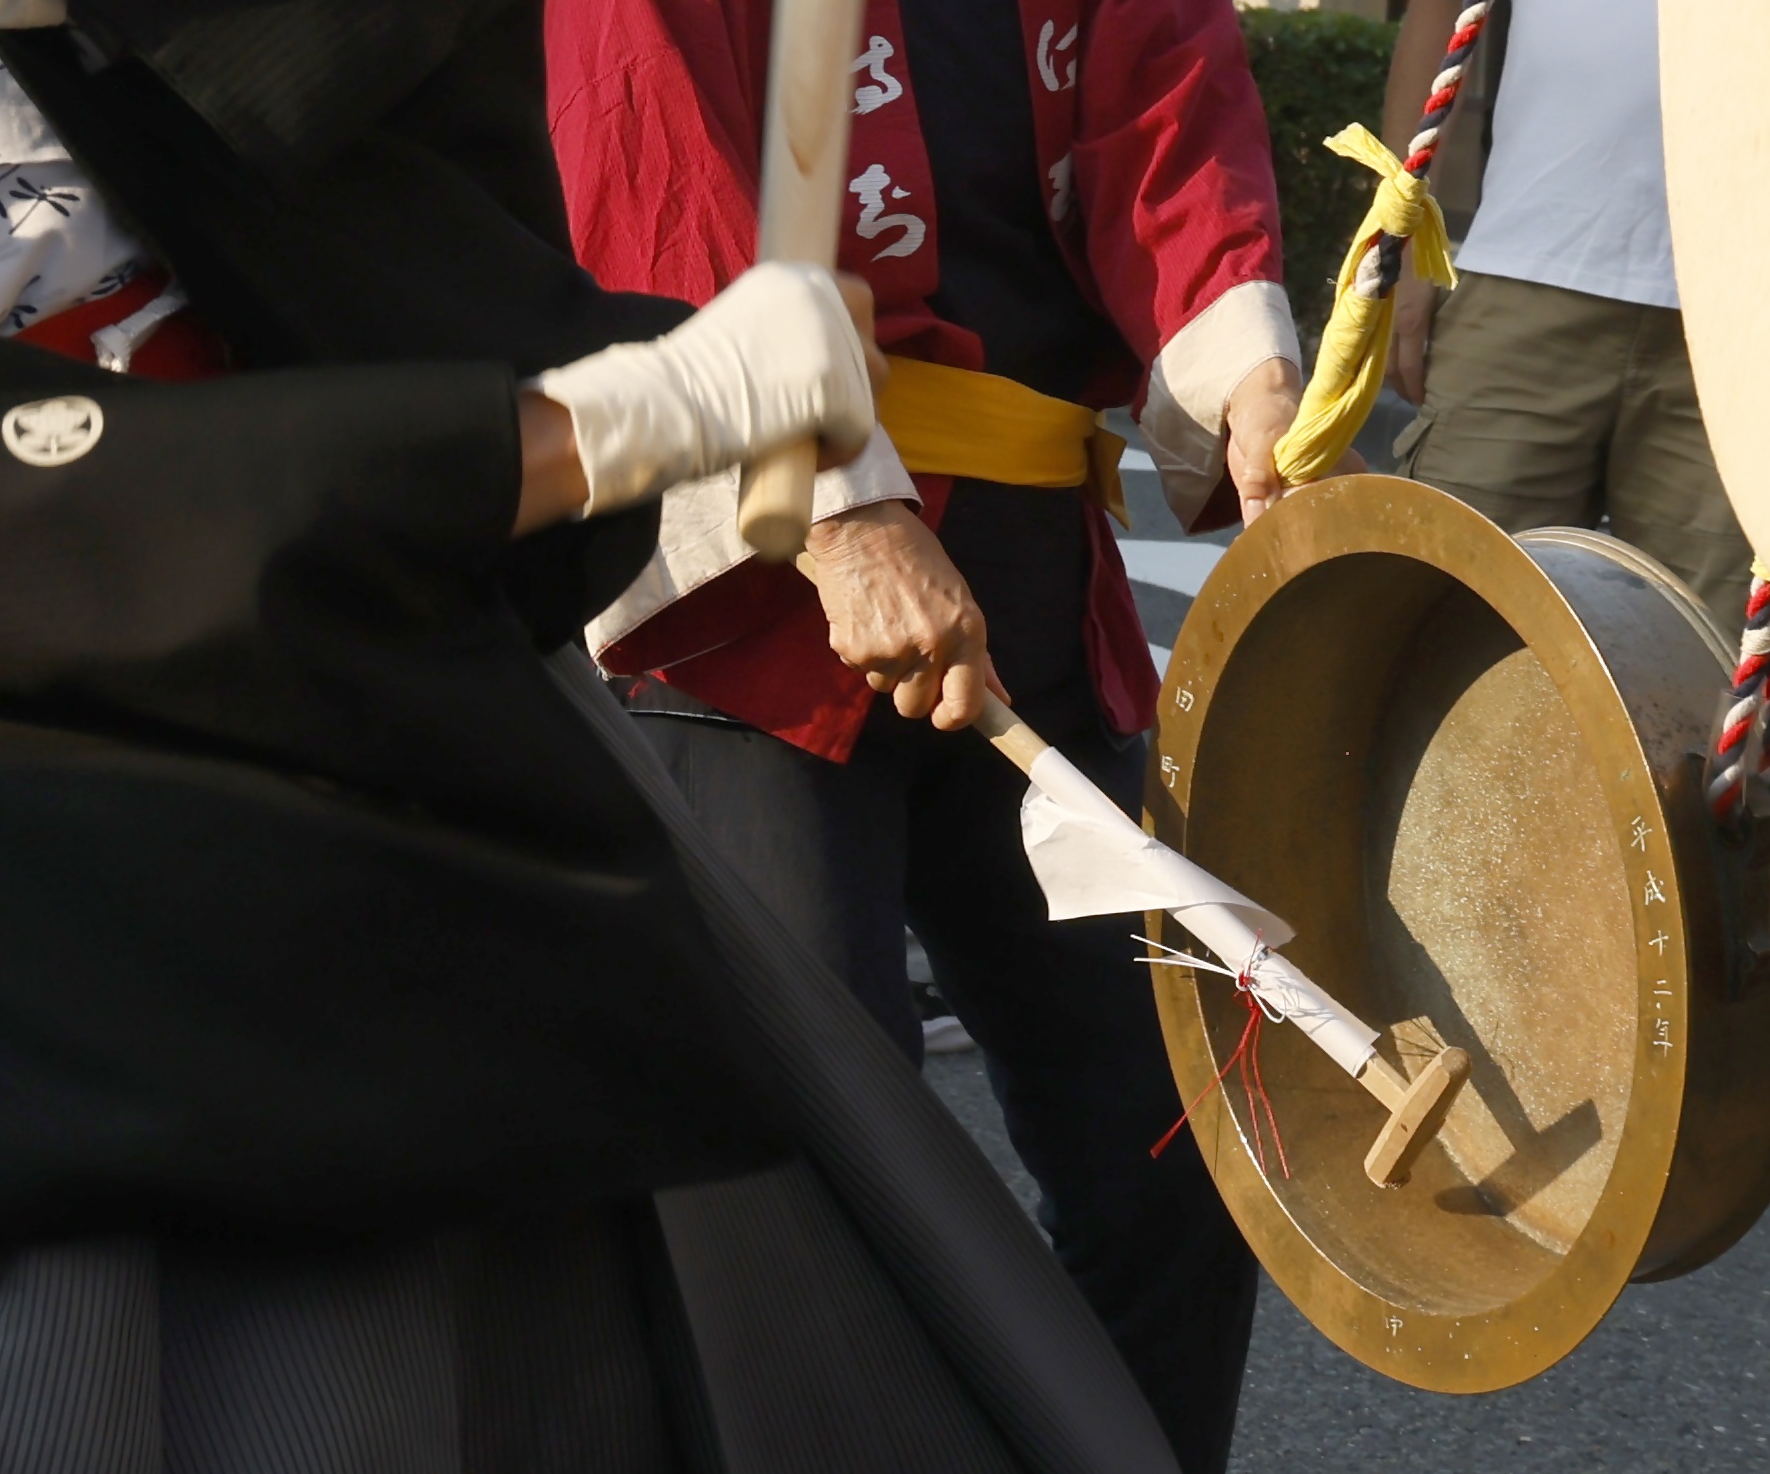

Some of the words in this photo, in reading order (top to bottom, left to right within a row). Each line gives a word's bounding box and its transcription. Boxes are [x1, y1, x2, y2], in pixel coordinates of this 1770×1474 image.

[1630, 815, 1675, 1058] 平成十二年
